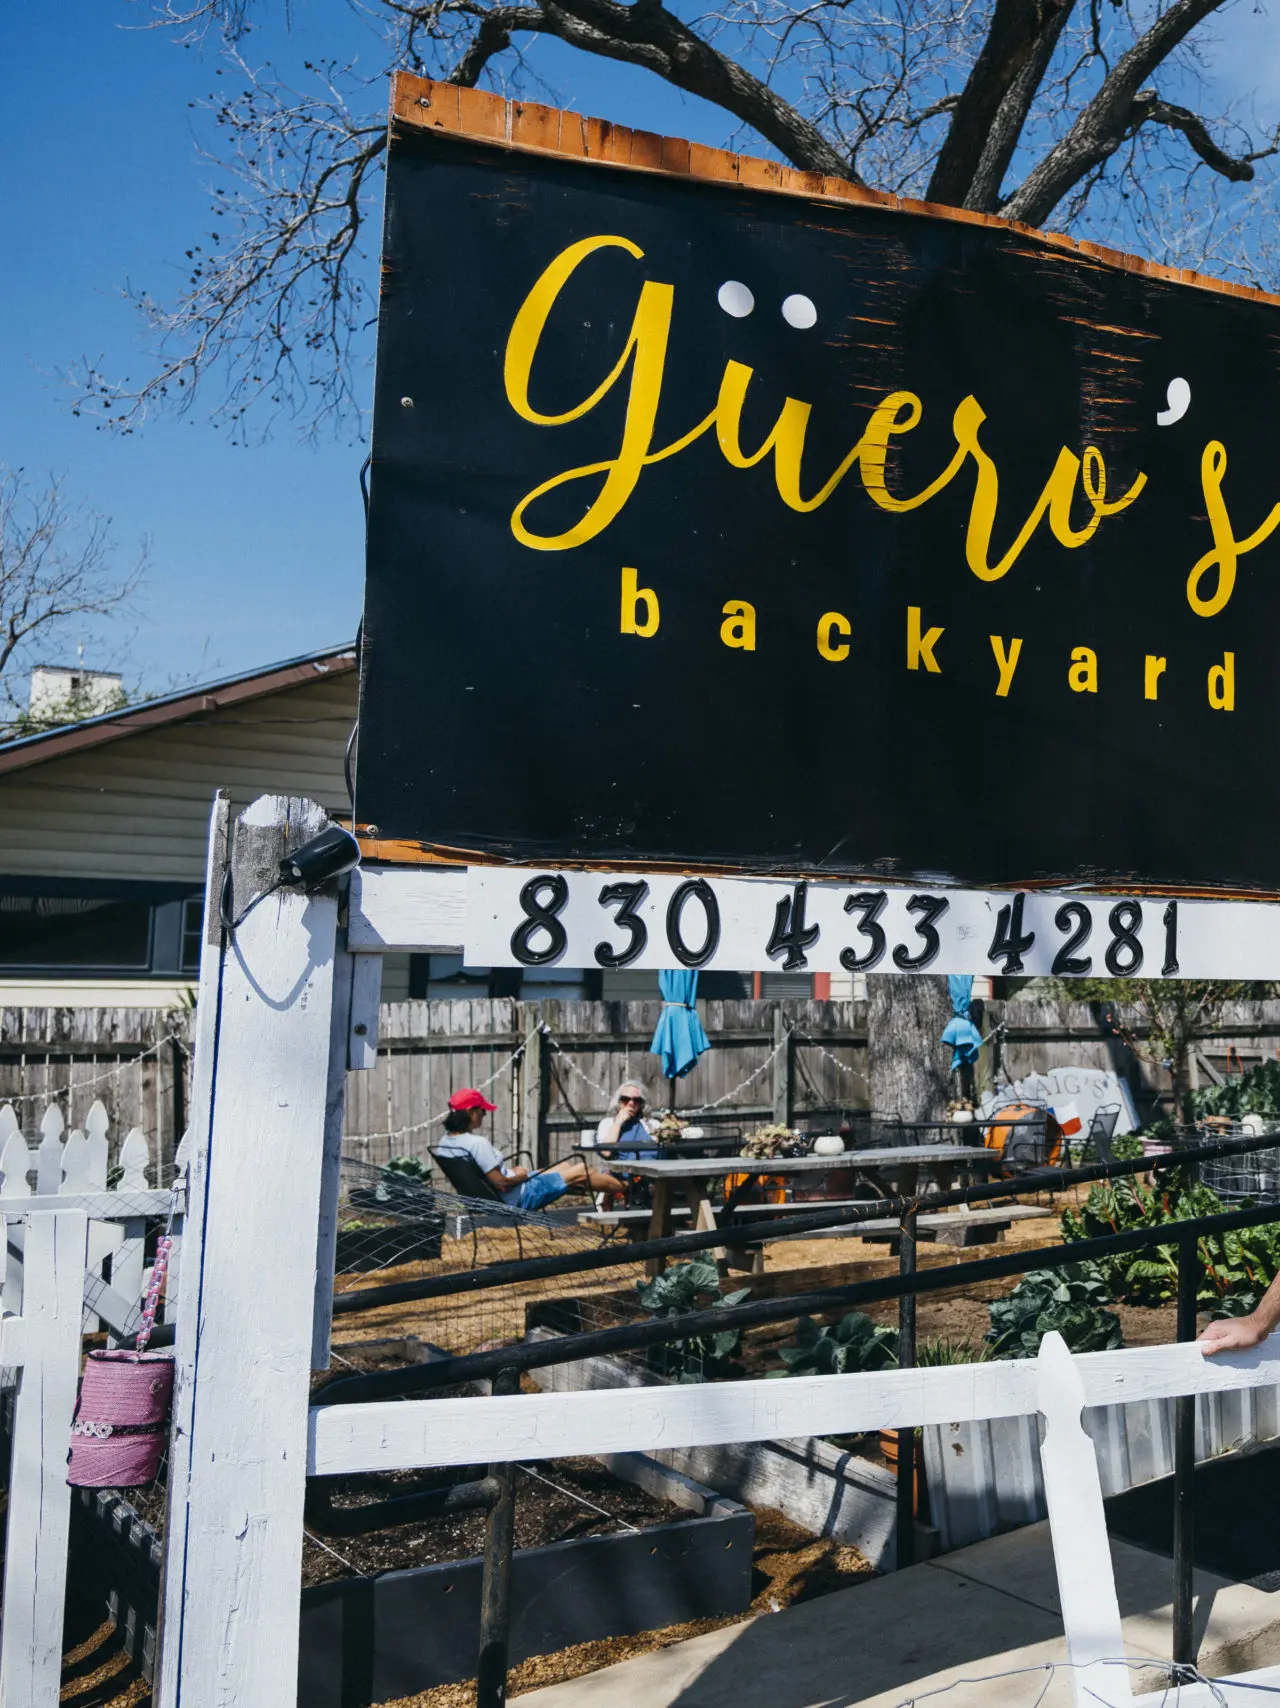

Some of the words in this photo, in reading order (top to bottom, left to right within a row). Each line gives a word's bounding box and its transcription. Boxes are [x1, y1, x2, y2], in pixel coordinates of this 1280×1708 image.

[620, 567, 1235, 712] backyard
[510, 874, 720, 967] 830
[765, 880, 950, 973] 433
[987, 891, 1180, 977] 4281
